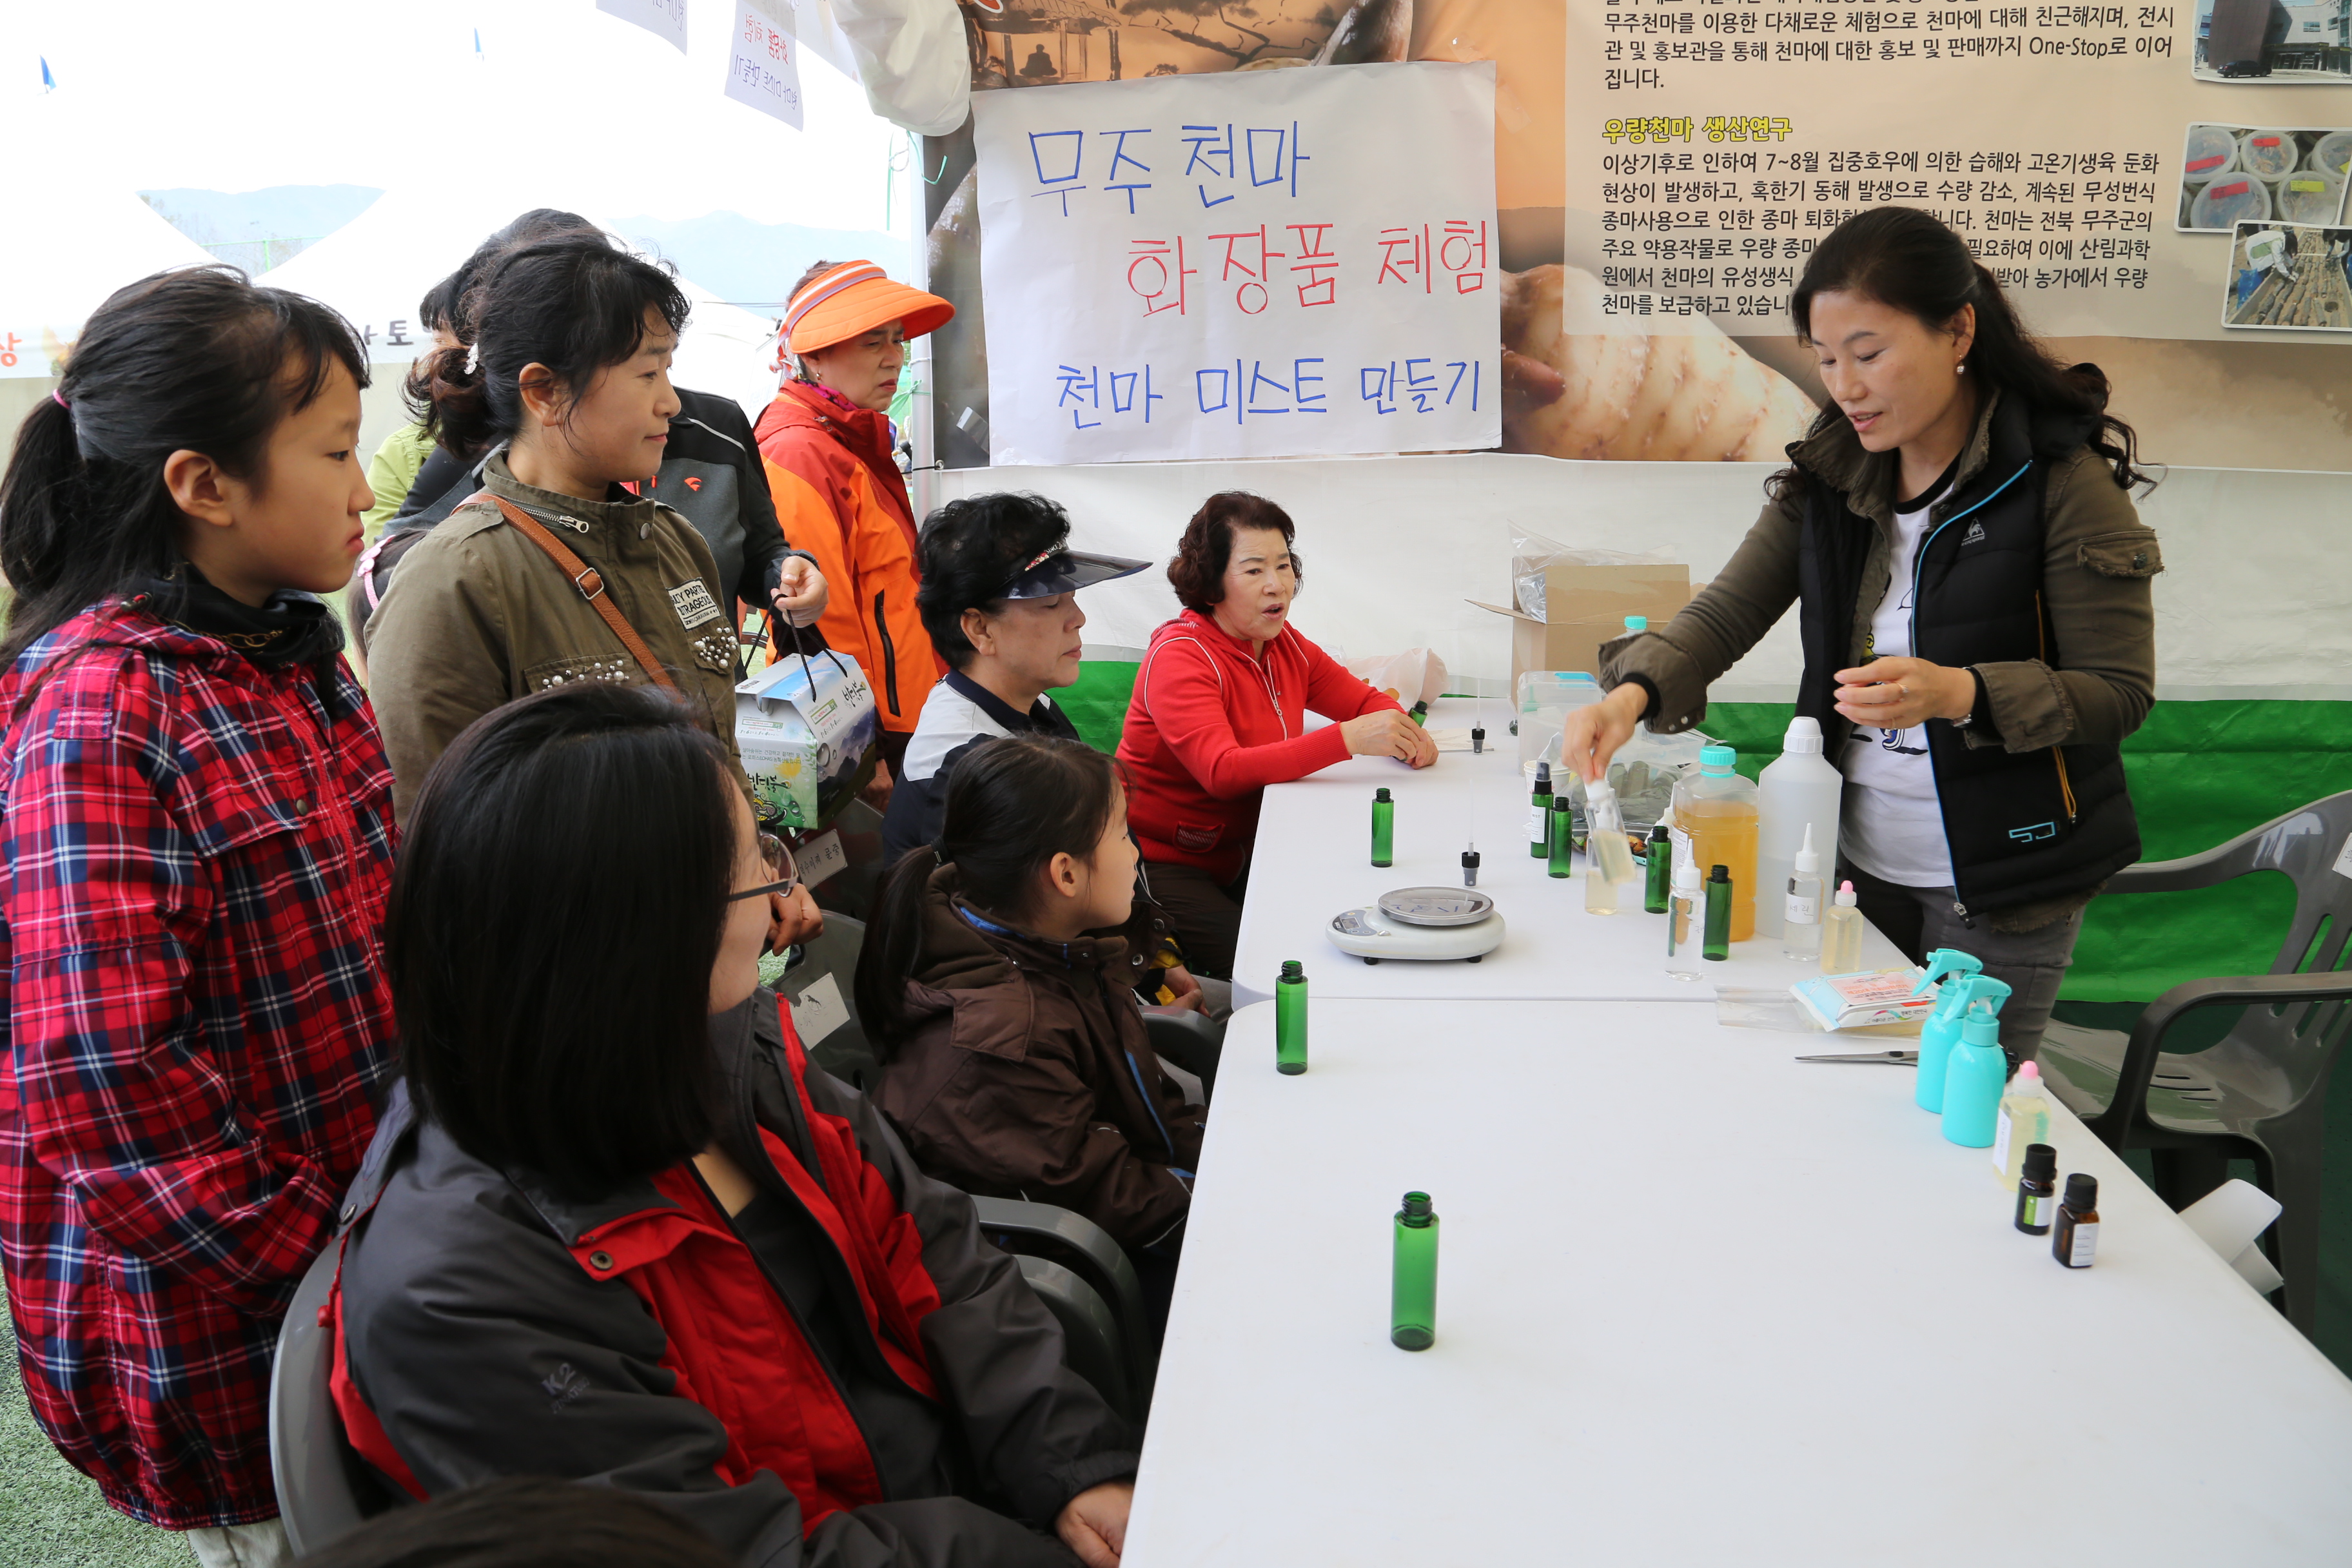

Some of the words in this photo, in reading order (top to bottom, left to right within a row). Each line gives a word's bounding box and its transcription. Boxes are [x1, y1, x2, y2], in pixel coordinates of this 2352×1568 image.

[1605, 13, 1695, 33] 무주천마를
[1704, 12, 1758, 33] 이용한
[1766, 12, 1838, 33] 다채로운
[1845, 12, 1917, 32] 체험으로
[1927, 10, 1981, 30] 천마에
[1990, 7, 2026, 27] 대해
[2036, 6, 2128, 28] 친근해지며,
[2138, 6, 2173, 27] 전시
[1605, 41, 1623, 60] 관
[1631, 41, 1645, 60] 및
[1653, 41, 1725, 61] 홍보관을
[1732, 42, 1767, 61] 통해
[1776, 41, 1828, 61] 천마에
[1836, 41, 1872, 61] 대한
[1879, 41, 1916, 60] 홍보
[1924, 39, 1940, 58] 및
[1948, 36, 2021, 57] 판매까지
[2030, 37, 2127, 59] One-Stop로
[2136, 36, 2171, 57] 이어
[1605, 68, 1663, 89] 집니다.
[1602, 116, 1694, 144] 우량천마
[1701, 116, 1793, 143] 생산연구
[1030, 130, 1151, 216] 무주
[1182, 122, 1309, 207] 천마
[1603, 153, 1694, 175] 이상기후로
[1703, 152, 1756, 173] 인하여
[1767, 152, 1818, 172] 7~8월
[1828, 152, 1918, 172] 집중호우에
[1926, 152, 1962, 172] 의한
[1969, 152, 2021, 173] 습해와
[2028, 152, 2116, 174] 고온기생육
[2124, 153, 2159, 174] 둔화
[1603, 182, 1654, 203] 현상이
[1665, 181, 1742, 202] 발생하고,
[1751, 181, 1805, 201] 혹한기
[1814, 181, 1849, 201] 동해
[1859, 181, 1929, 201] 발생으로
[1937, 181, 1972, 201] 수량
[1980, 181, 2016, 202] 감소,
[2026, 182, 2074, 203] 계속된
[2083, 181, 2155, 203] 무성번식
[1602, 211, 1710, 231] 종마사용으로
[1719, 210, 1754, 230] 인한
[1761, 210, 1798, 230] 종마
[1924, 209, 1977, 231] 니다.
[1985, 210, 2033, 231] 천마는
[2041, 211, 2073, 231] 전북
[2082, 210, 2151, 232] 무주군의
[1602, 239, 1636, 258] 주요
[1643, 239, 1733, 259] 약용작물로
[1740, 239, 1777, 259] 우량
[1967, 239, 2032, 261] 필요하여
[2039, 240, 2072, 260] 이에
[2080, 239, 2150, 260] 산림과학
[1128, 224, 1339, 317] 화장품
[1378, 220, 1486, 294] 체험
[1602, 267, 1652, 288] 원에서
[1661, 268, 1713, 288] 천마의
[1722, 267, 1793, 287] 유성생식
[1991, 267, 2029, 289] 받아
[2035, 267, 2107, 288] 농가에서
[2115, 268, 2148, 289] 우량
[1603, 295, 1653, 315] 천마를
[1659, 296, 1730, 316] 보급하고
[1736, 295, 1790, 317] 있습니
[1057, 365, 1162, 429] 천마
[1197, 358, 1327, 424] 미스트
[1361, 358, 1478, 414] 만들기
[541, 1362, 576, 1397] K2
